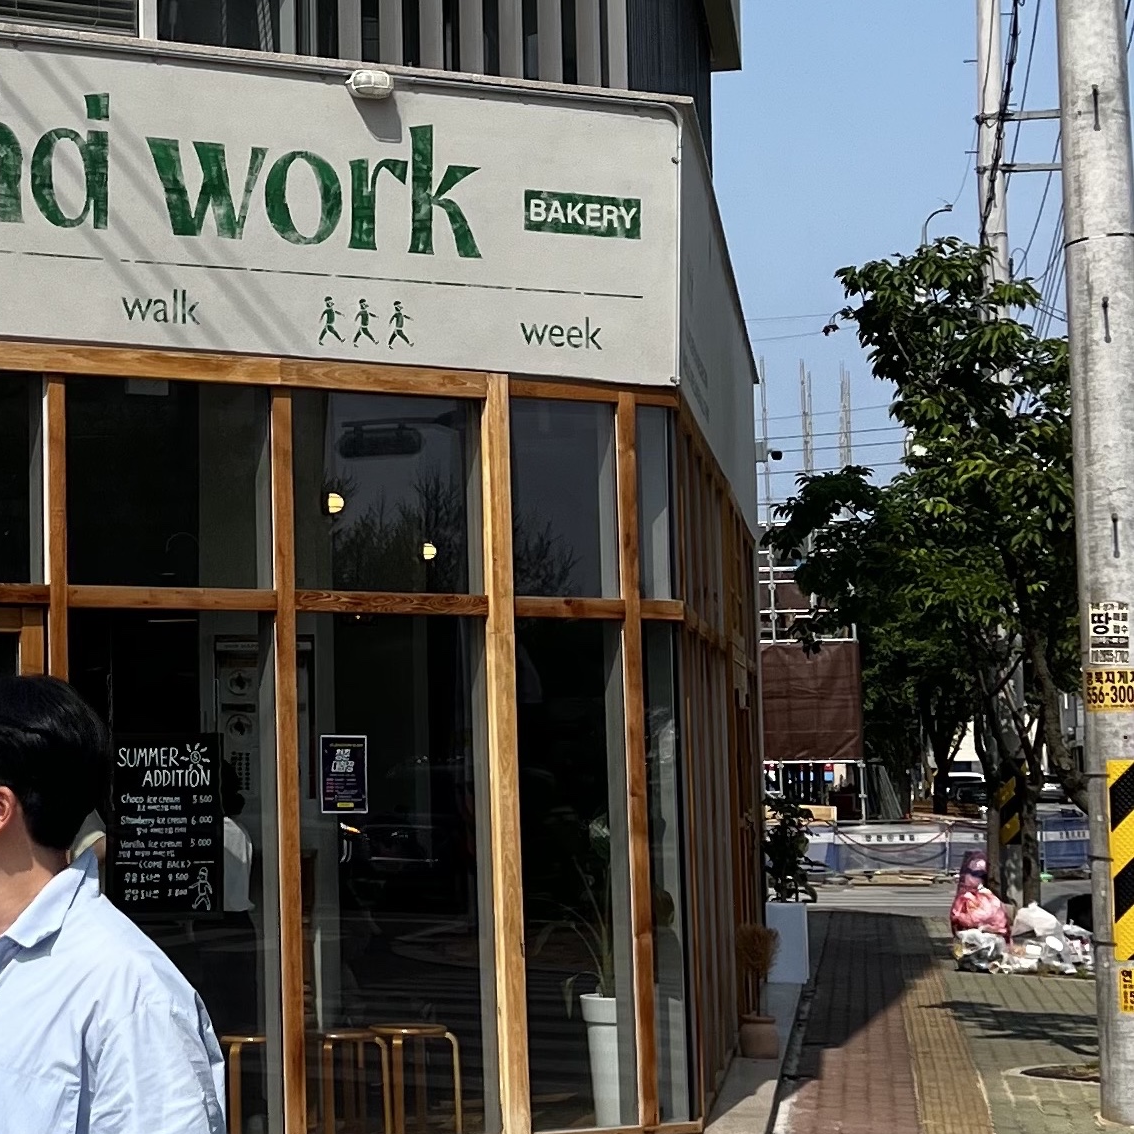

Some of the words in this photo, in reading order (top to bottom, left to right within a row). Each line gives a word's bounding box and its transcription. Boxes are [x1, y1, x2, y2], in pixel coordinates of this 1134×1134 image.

[145, 125, 483, 259] work
[529, 198, 637, 231] BAKERY
[122, 289, 201, 326] walk
[520, 317, 602, 351] week
[117, 747, 179, 768] SUMMER
[142, 769, 211, 788] ADDITION
